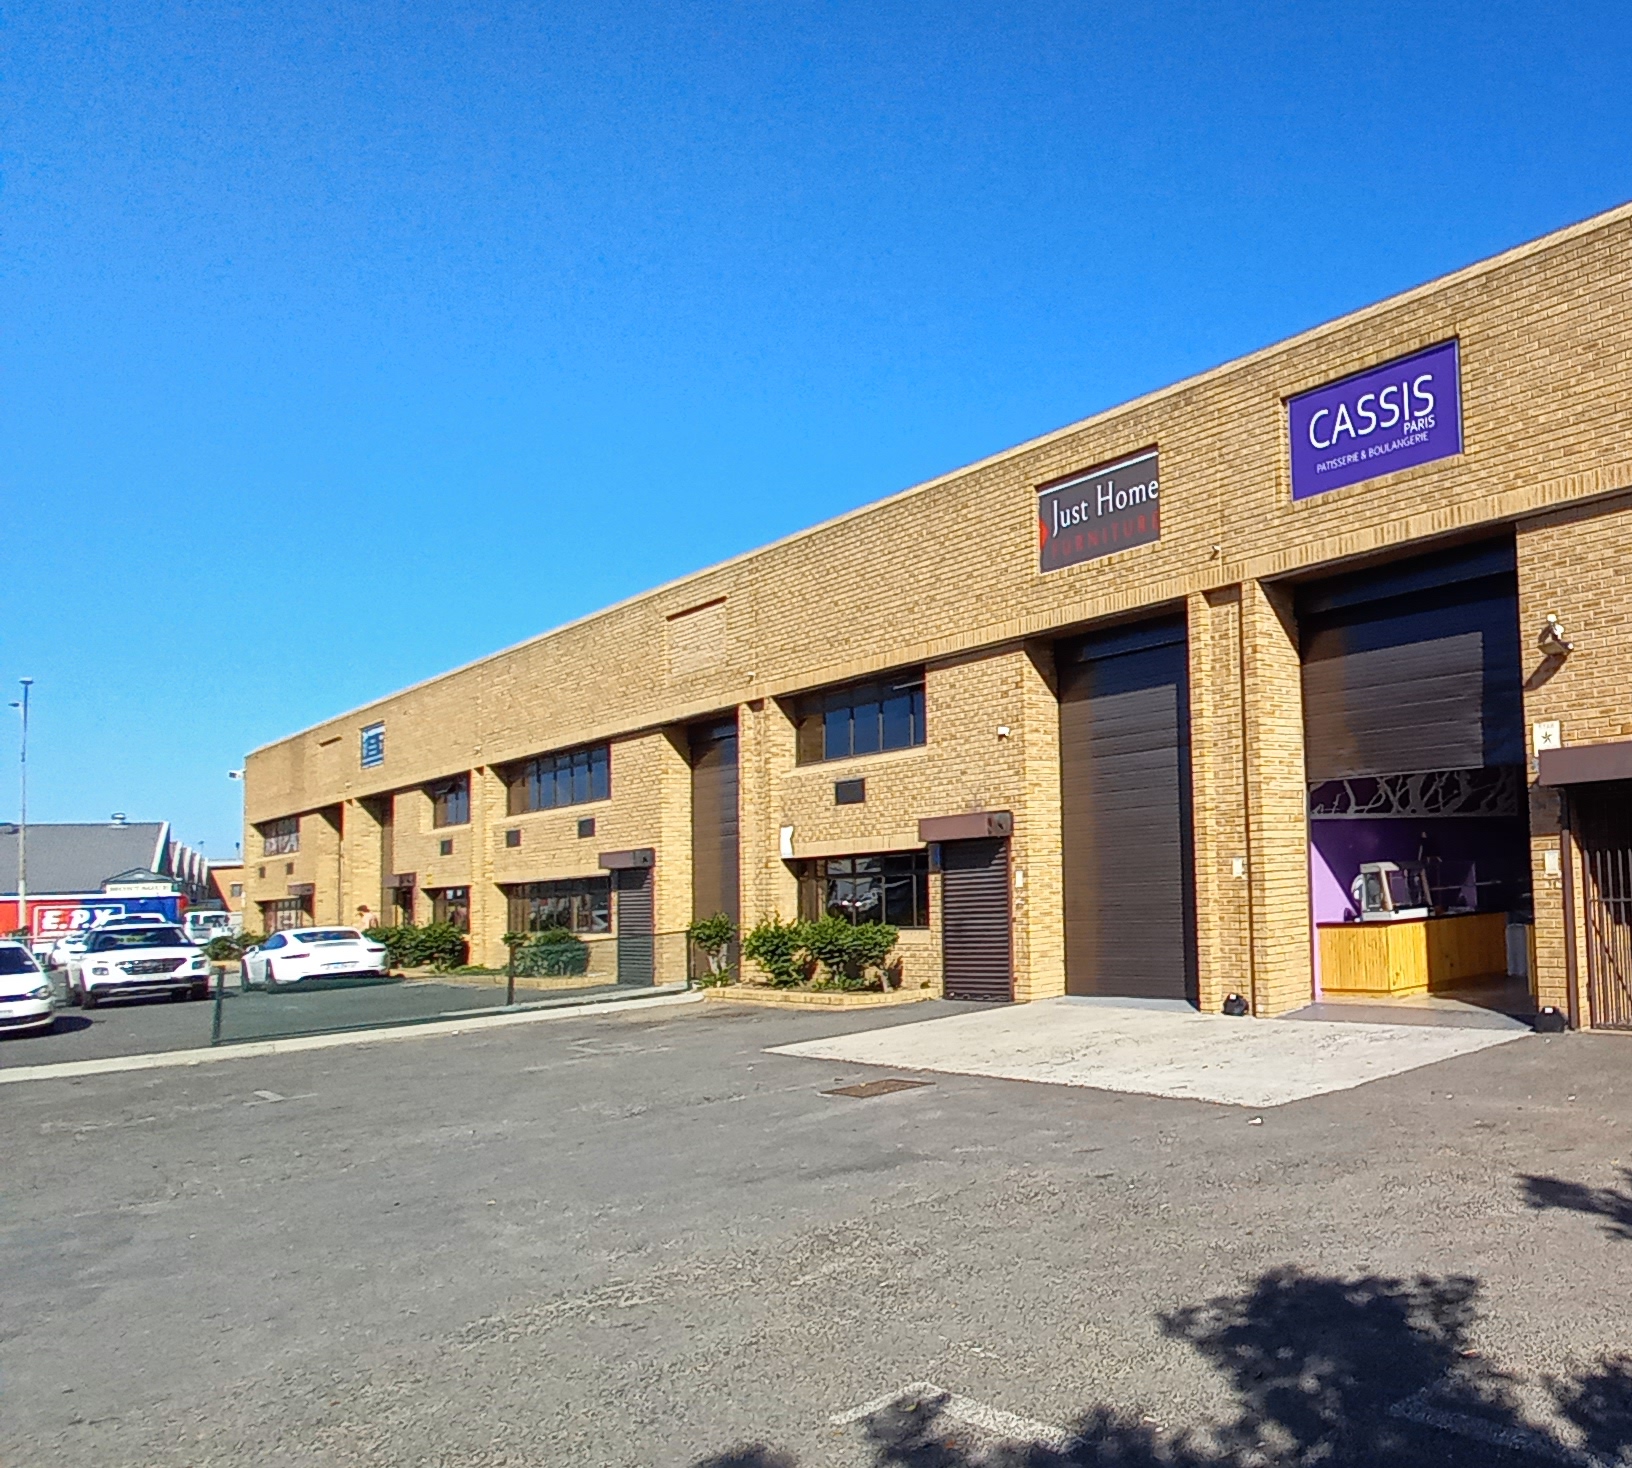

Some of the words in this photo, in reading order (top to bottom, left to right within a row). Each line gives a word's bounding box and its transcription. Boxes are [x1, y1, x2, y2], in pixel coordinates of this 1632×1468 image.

[1309, 374, 1435, 448] CASSIS
[1403, 414, 1436, 435] PARIS
[1316, 451, 1359, 474] PATISSERIE
[1361, 449, 1367, 461] &
[1368, 431, 1429, 458] BOULANGERIE
[1052, 499, 1088, 538] Just
[1096, 480, 1159, 516] Home
